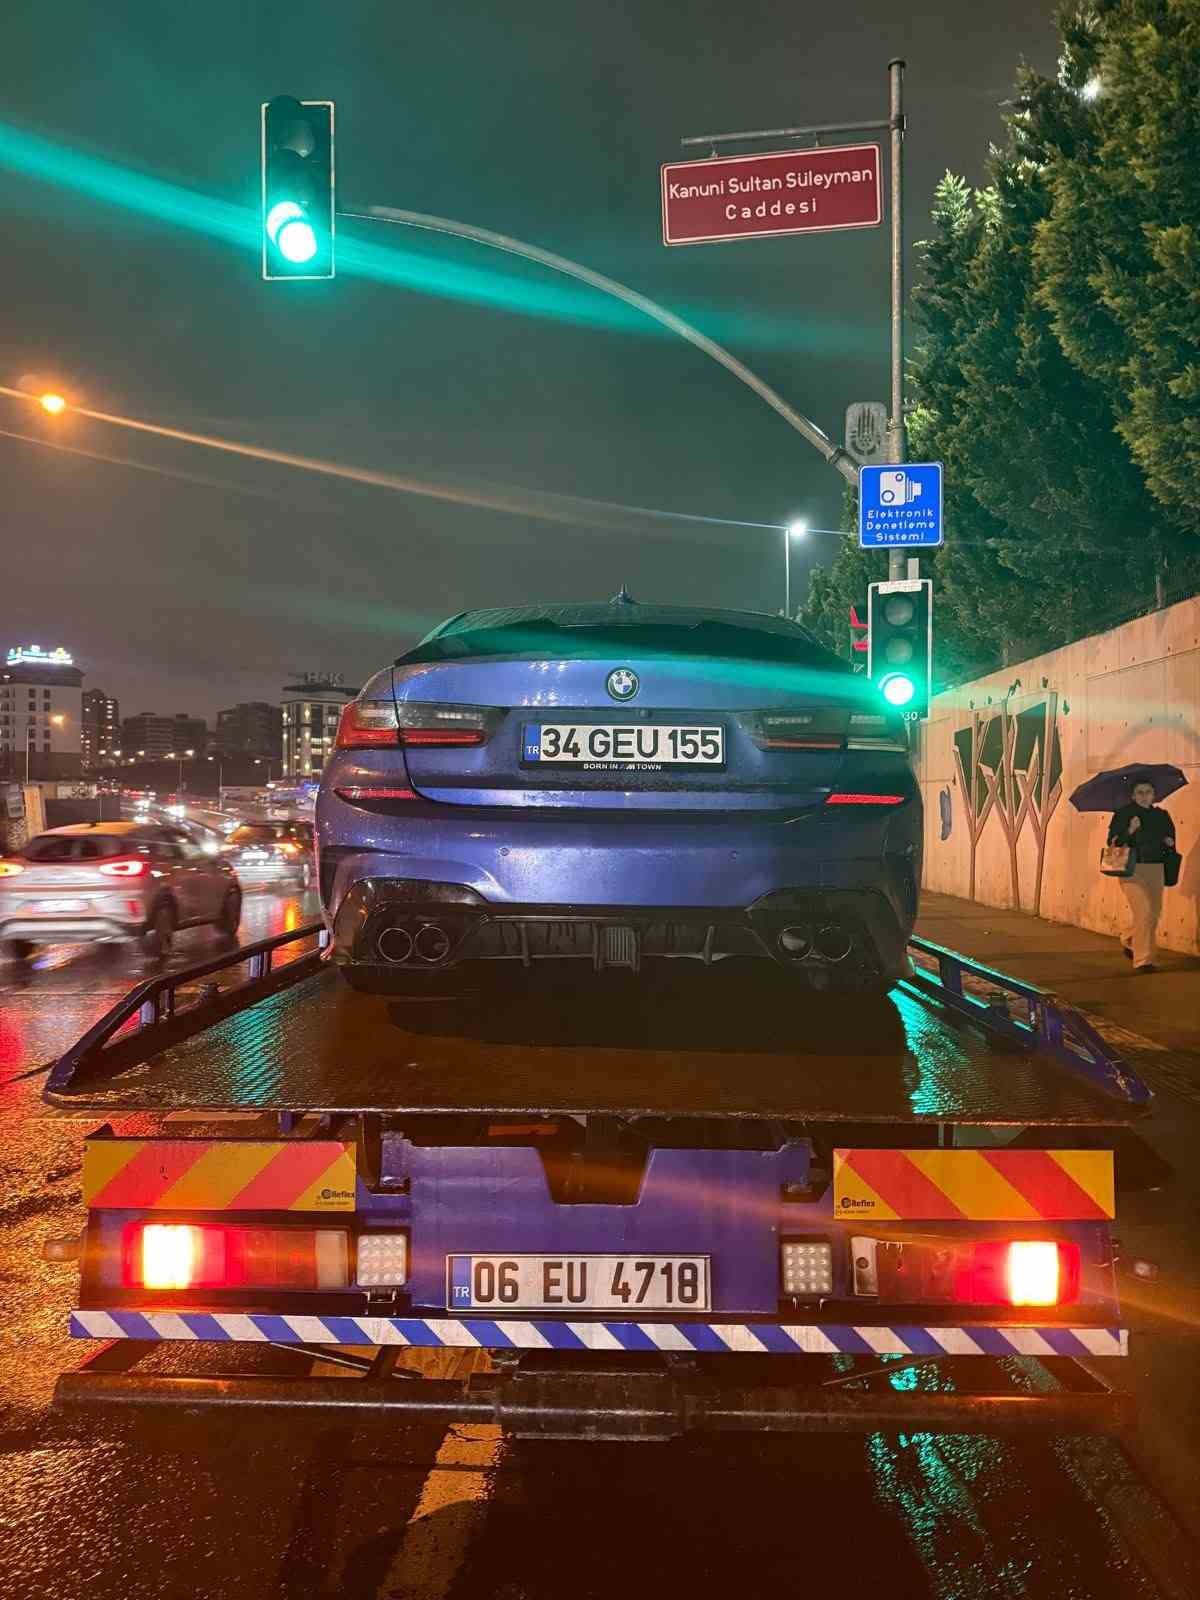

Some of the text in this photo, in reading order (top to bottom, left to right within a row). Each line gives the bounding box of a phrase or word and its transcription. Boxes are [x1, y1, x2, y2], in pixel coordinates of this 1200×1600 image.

[669, 168, 873, 199] Kanuni Sultan Süleyman
[725, 198, 817, 220] Caddesi
[867, 508, 934, 519] Elektronik
[866, 520, 935, 530] Denetleme
[876, 532, 925, 541] Sistemi
[526, 728, 720, 760] TR 34 GEU 155
[453, 1261, 698, 1304] TR 06 EU 4718
